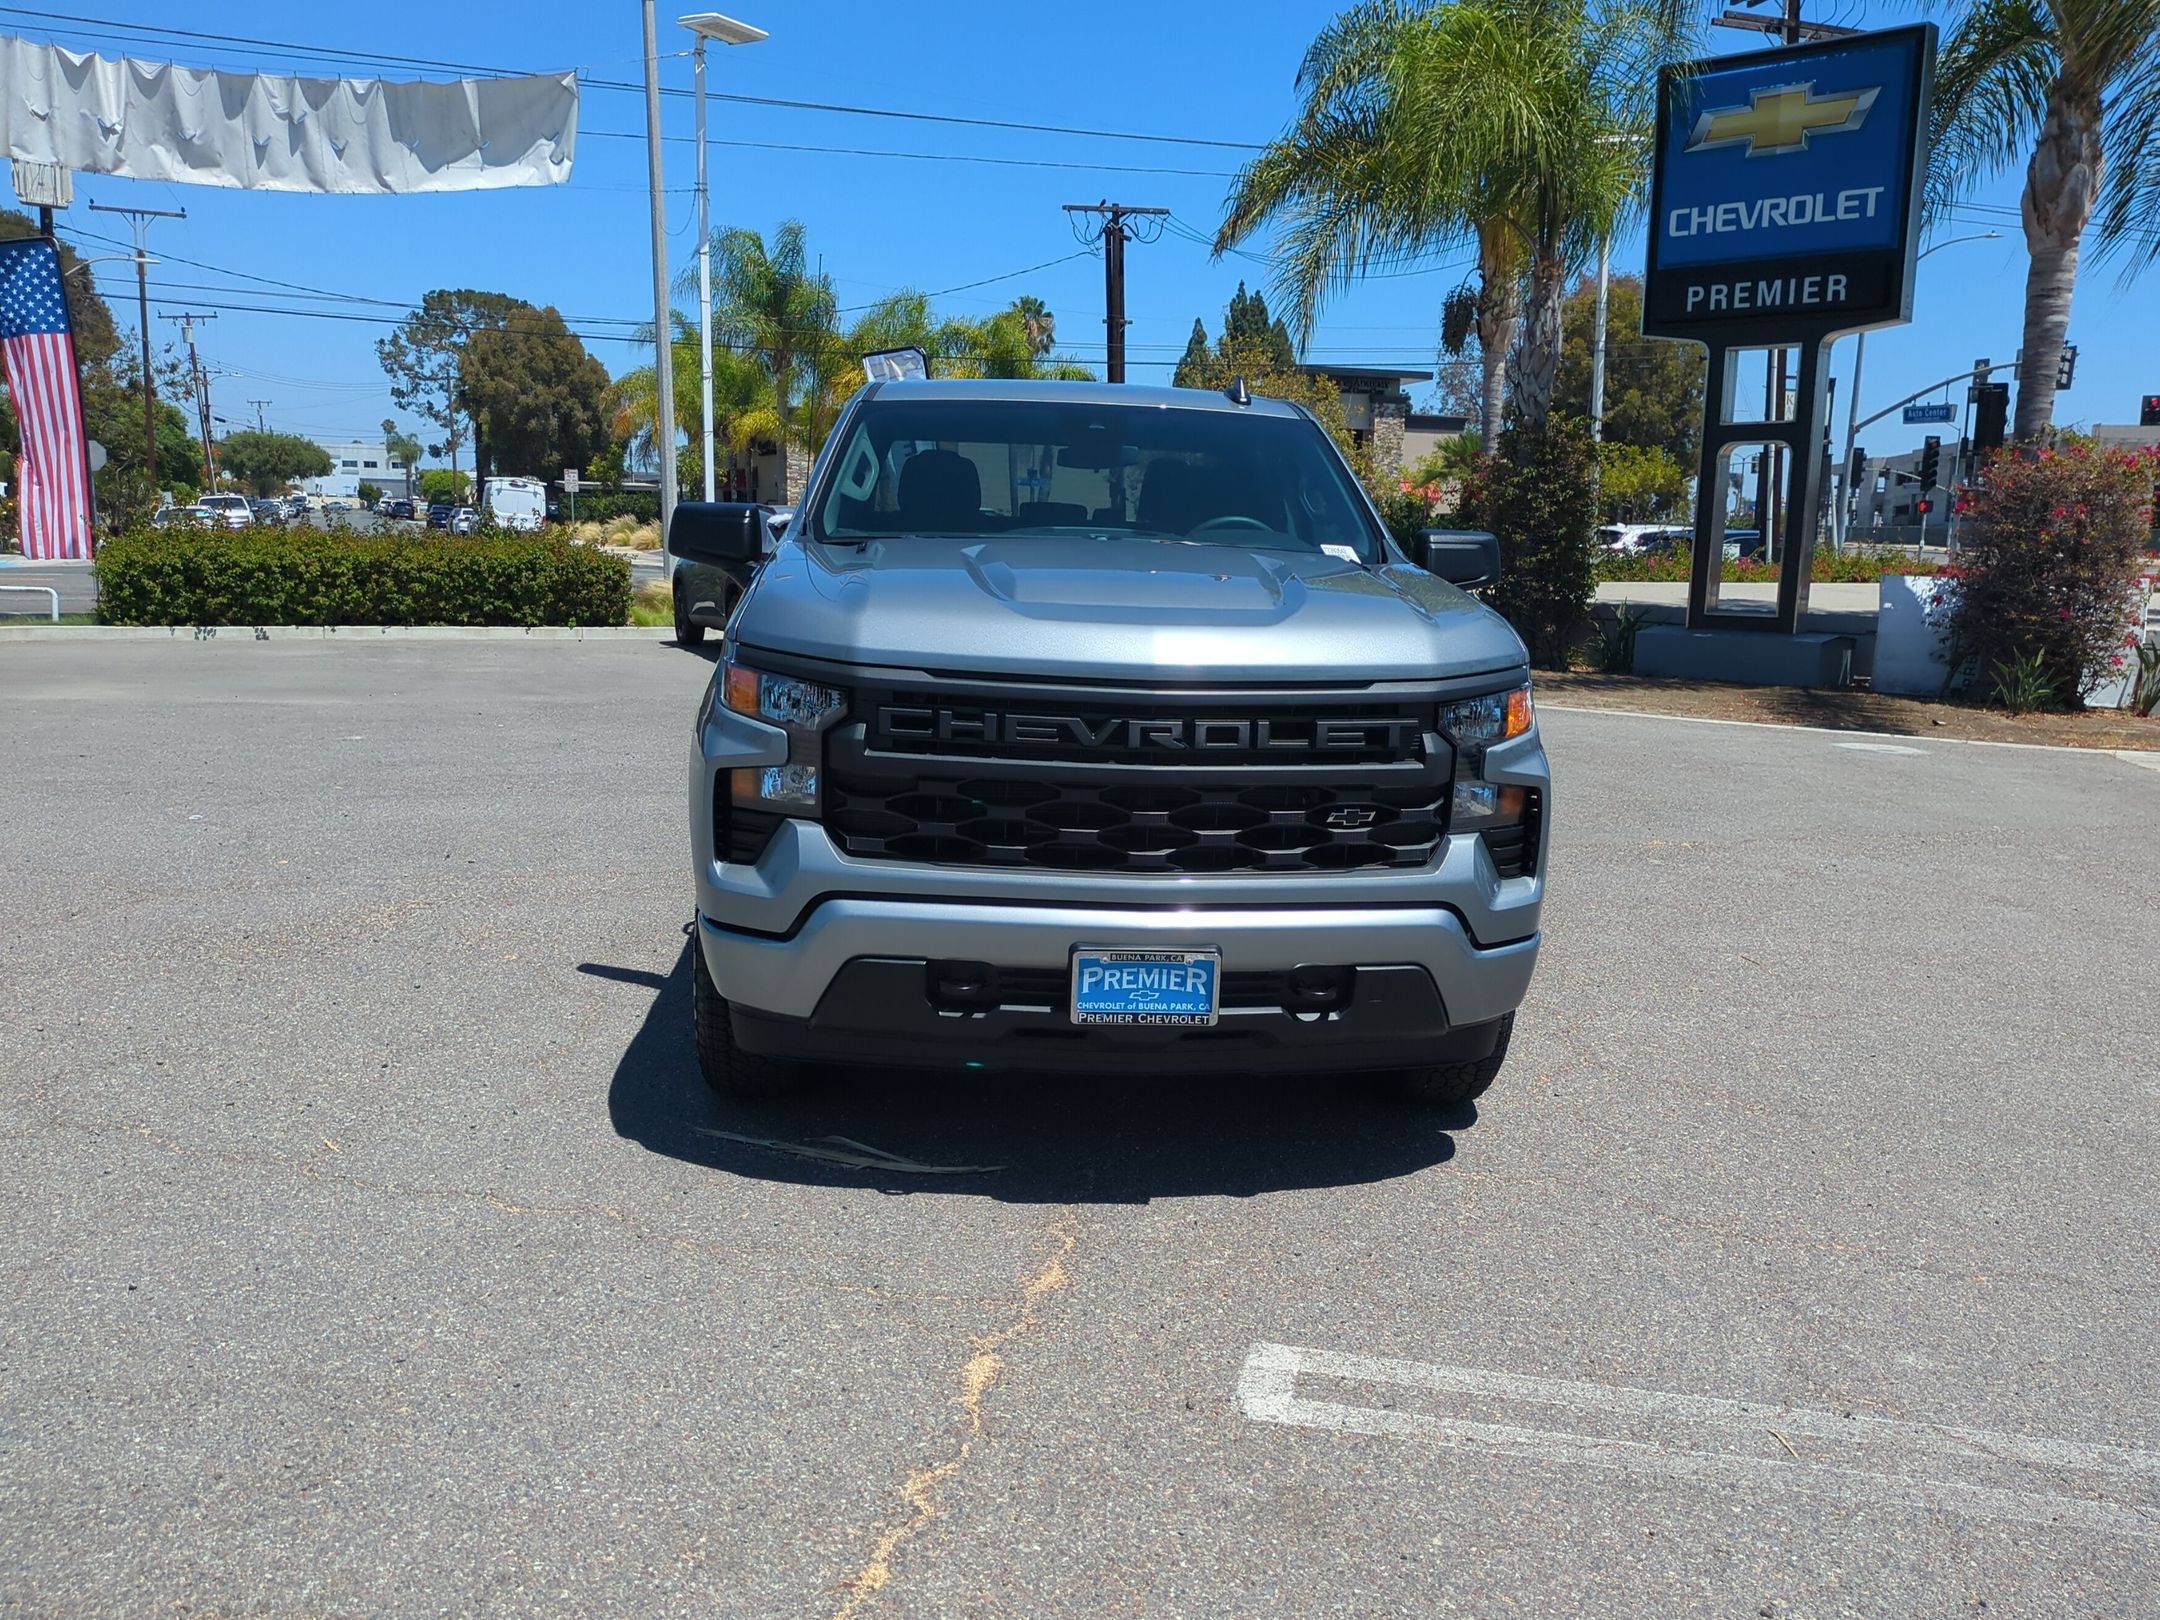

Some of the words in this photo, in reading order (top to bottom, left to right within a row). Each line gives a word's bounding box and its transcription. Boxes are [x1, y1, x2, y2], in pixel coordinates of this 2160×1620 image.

[1669, 186, 1884, 237] CHEVROLET
[1687, 274, 1847, 312] PREMIER
[1908, 409, 1923, 417] Auto
[1925, 408, 1947, 417] Center
[879, 706, 1420, 750] CHEVROLET
[1171, 954, 1182, 962] CA
[1081, 967, 1208, 995] PREMIER
[1077, 1002, 1125, 1010] CHEVROLET
[1128, 1002, 1137, 1010] of
[1139, 1002, 1167, 1010] BUENA
[1170, 1003, 1196, 1011] PARK,
[1199, 1003, 1210, 1011] CA
[1078, 1013, 1133, 1023] PREMIER
[1138, 1014, 1209, 1024] CHEVROLET
